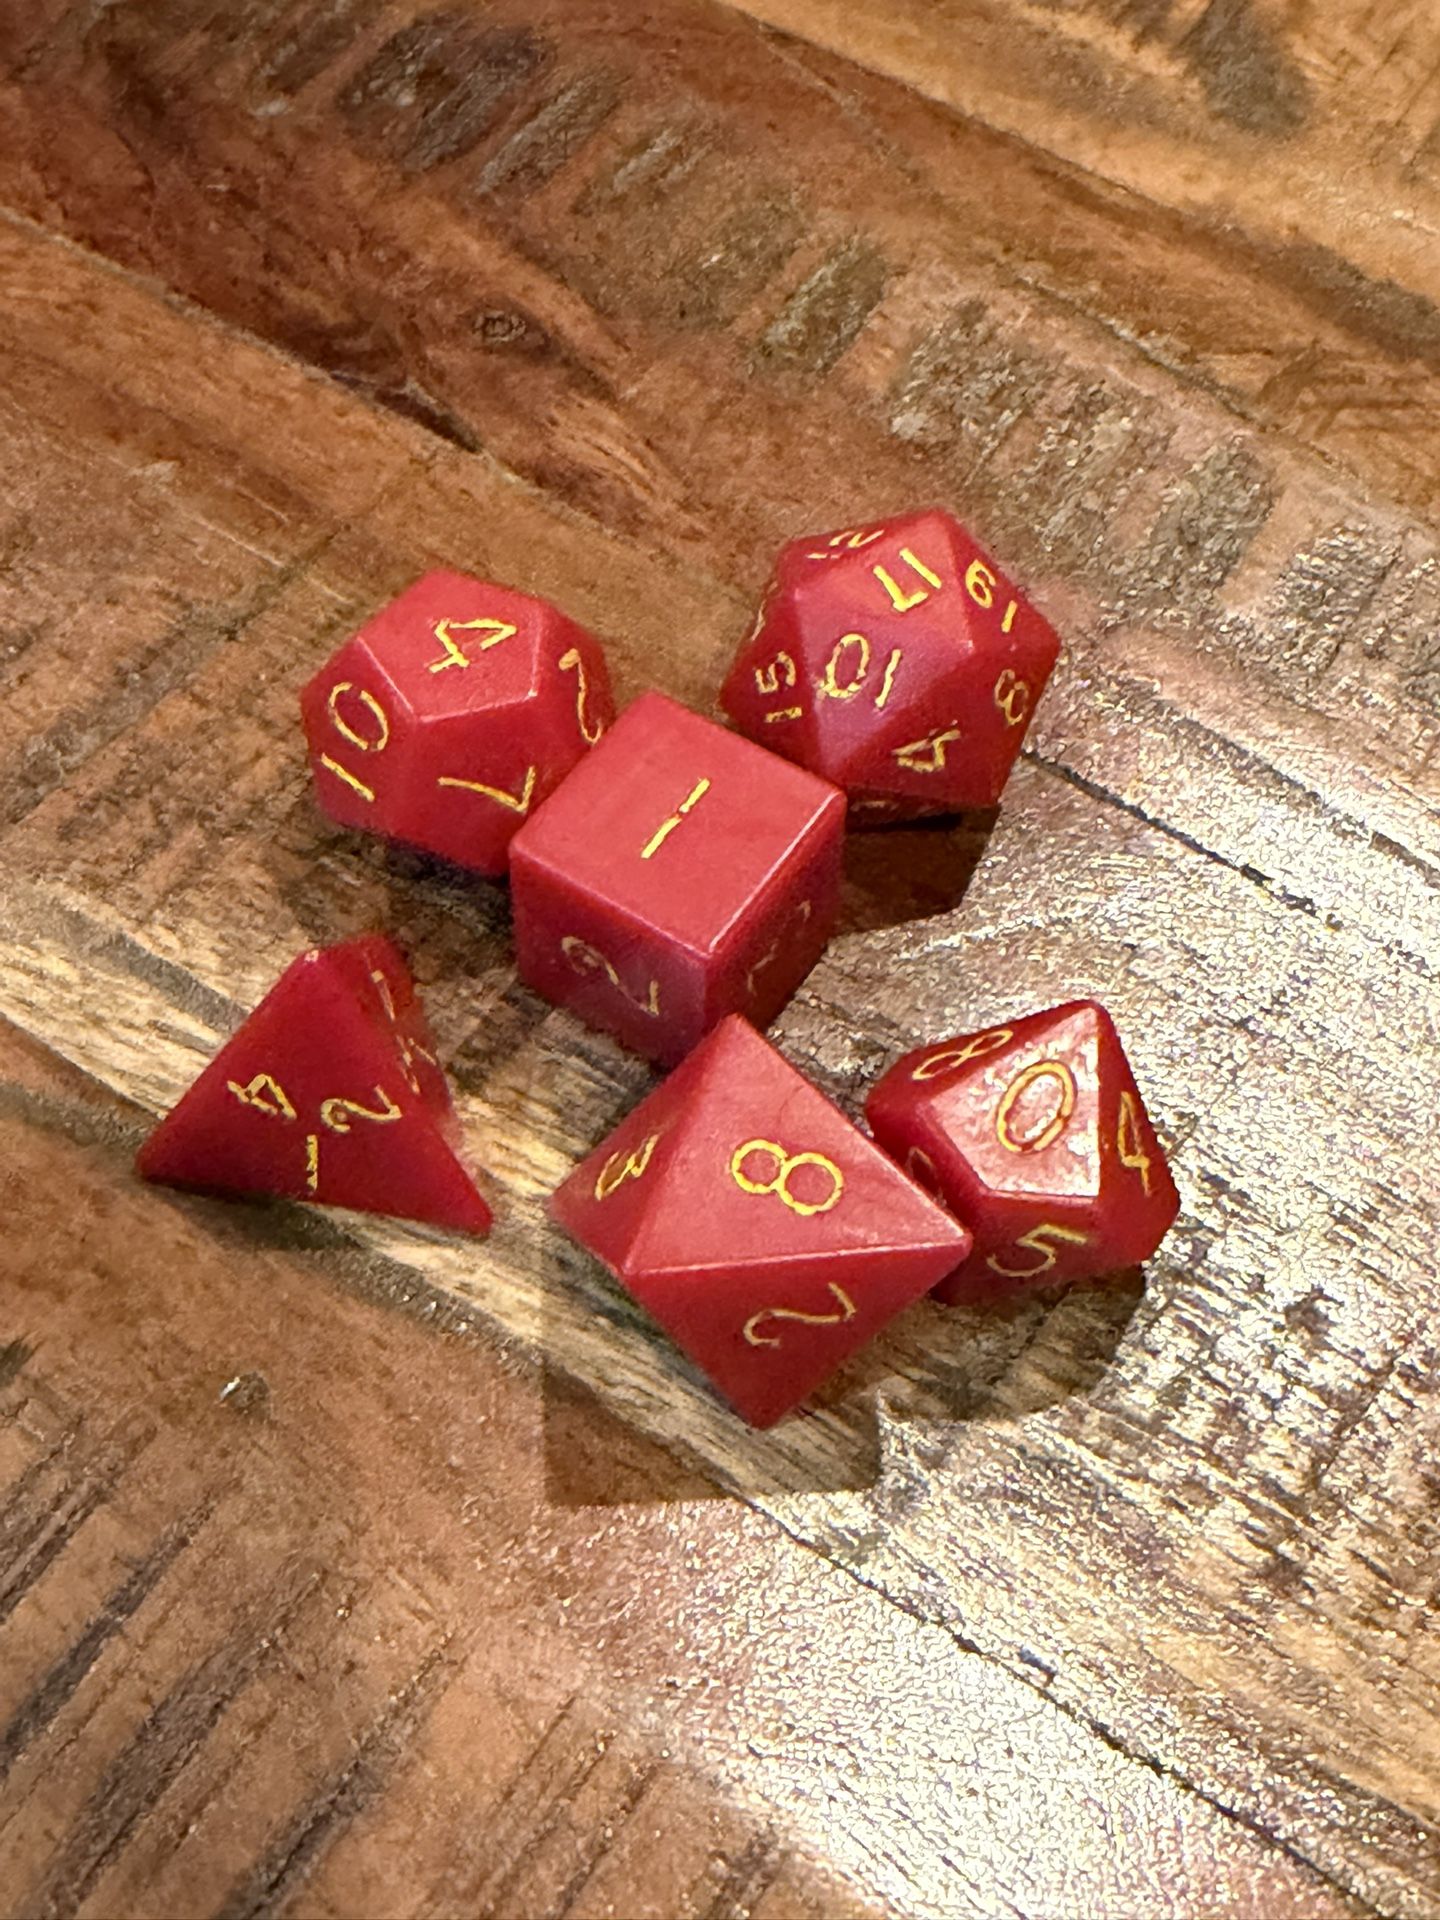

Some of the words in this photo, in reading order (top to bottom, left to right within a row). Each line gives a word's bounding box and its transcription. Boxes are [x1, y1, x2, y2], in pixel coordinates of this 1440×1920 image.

[872, 548, 942, 612] 17
[427, 617, 517, 674] 4
[812, 633, 902, 712] 10
[755, 651, 802, 724] 15
[319, 681, 390, 804] 10
[437, 765, 536, 815] 7
[640, 777, 711, 859] 1
[911, 1029, 1015, 1081] 8
[226, 1072, 298, 1121] 4
[319, 1084, 403, 1134] 2
[305, 1134, 319, 1192] 1
[1116, 1090, 1150, 1198] 4
[730, 1138, 844, 1216] 8
[985, 1223, 1089, 1277] 5
[742, 1282, 858, 1350] 2
